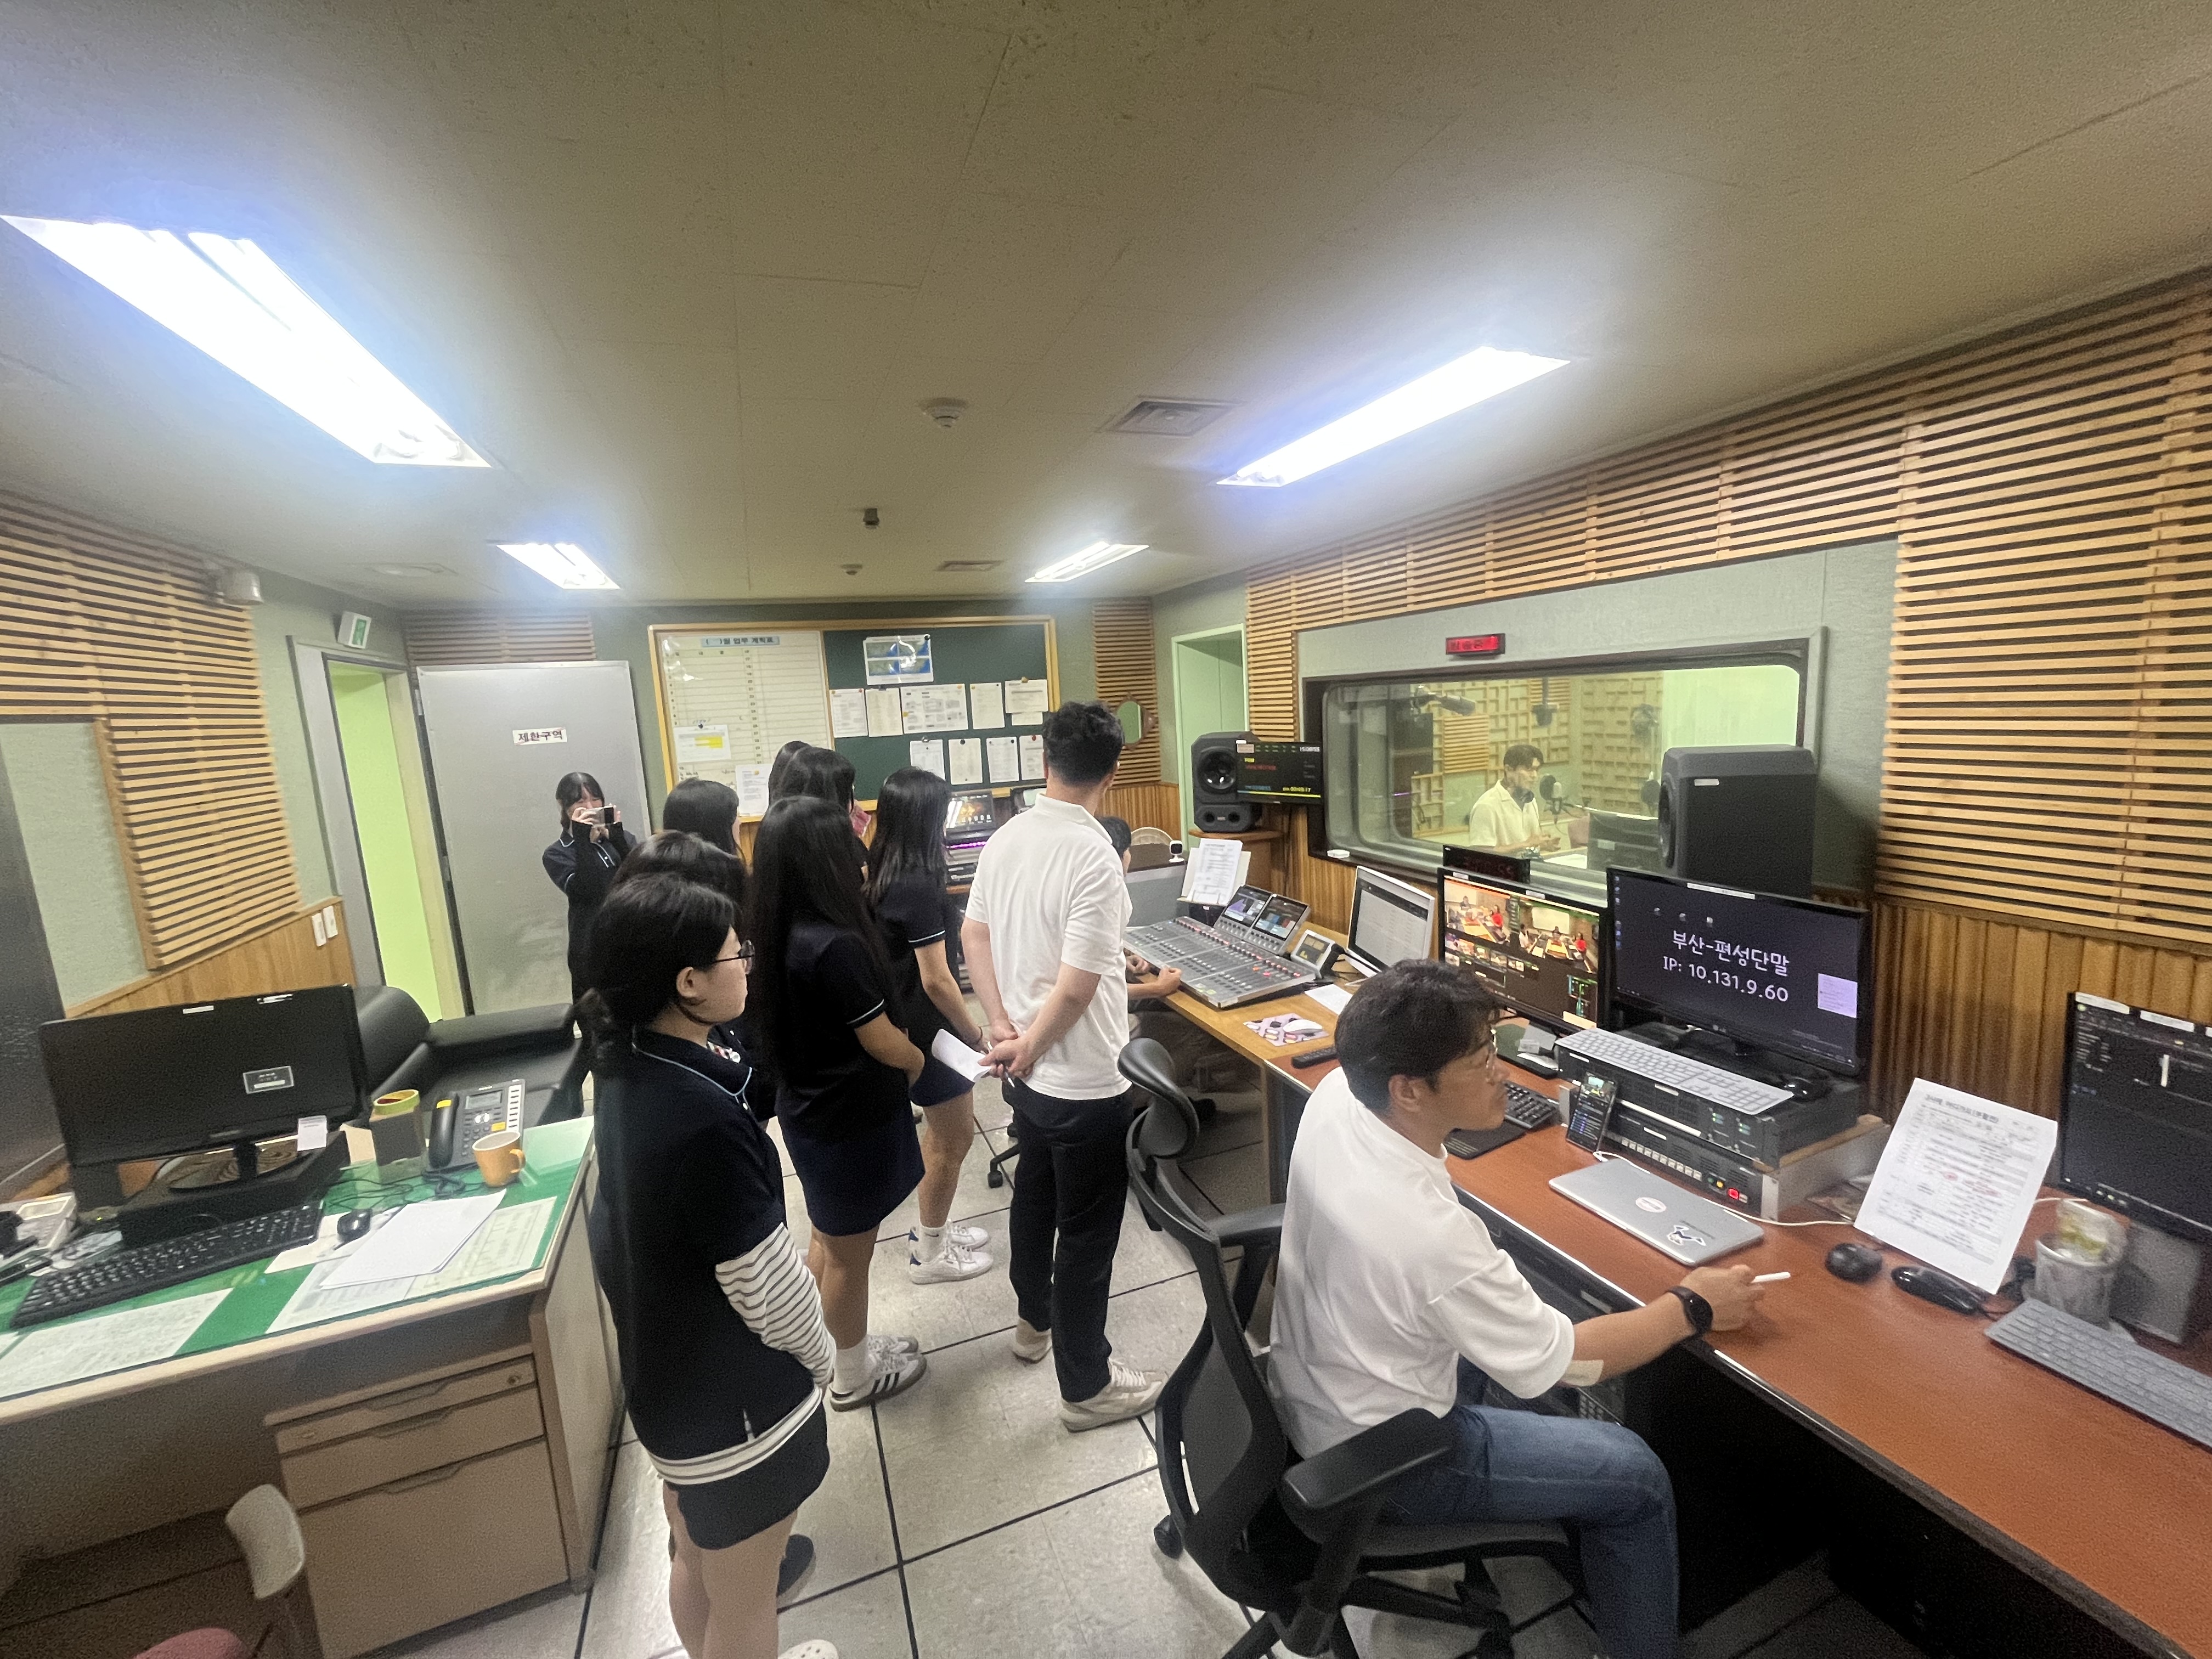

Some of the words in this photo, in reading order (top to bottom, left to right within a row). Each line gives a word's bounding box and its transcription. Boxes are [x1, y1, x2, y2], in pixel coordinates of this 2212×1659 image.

[518, 730, 563, 742] 제한구역
[1673, 930, 1790, 977] 부산-편성단말
[1663, 956, 1682, 972] IP:
[1689, 963, 1788, 1002] 10.131.9.60
